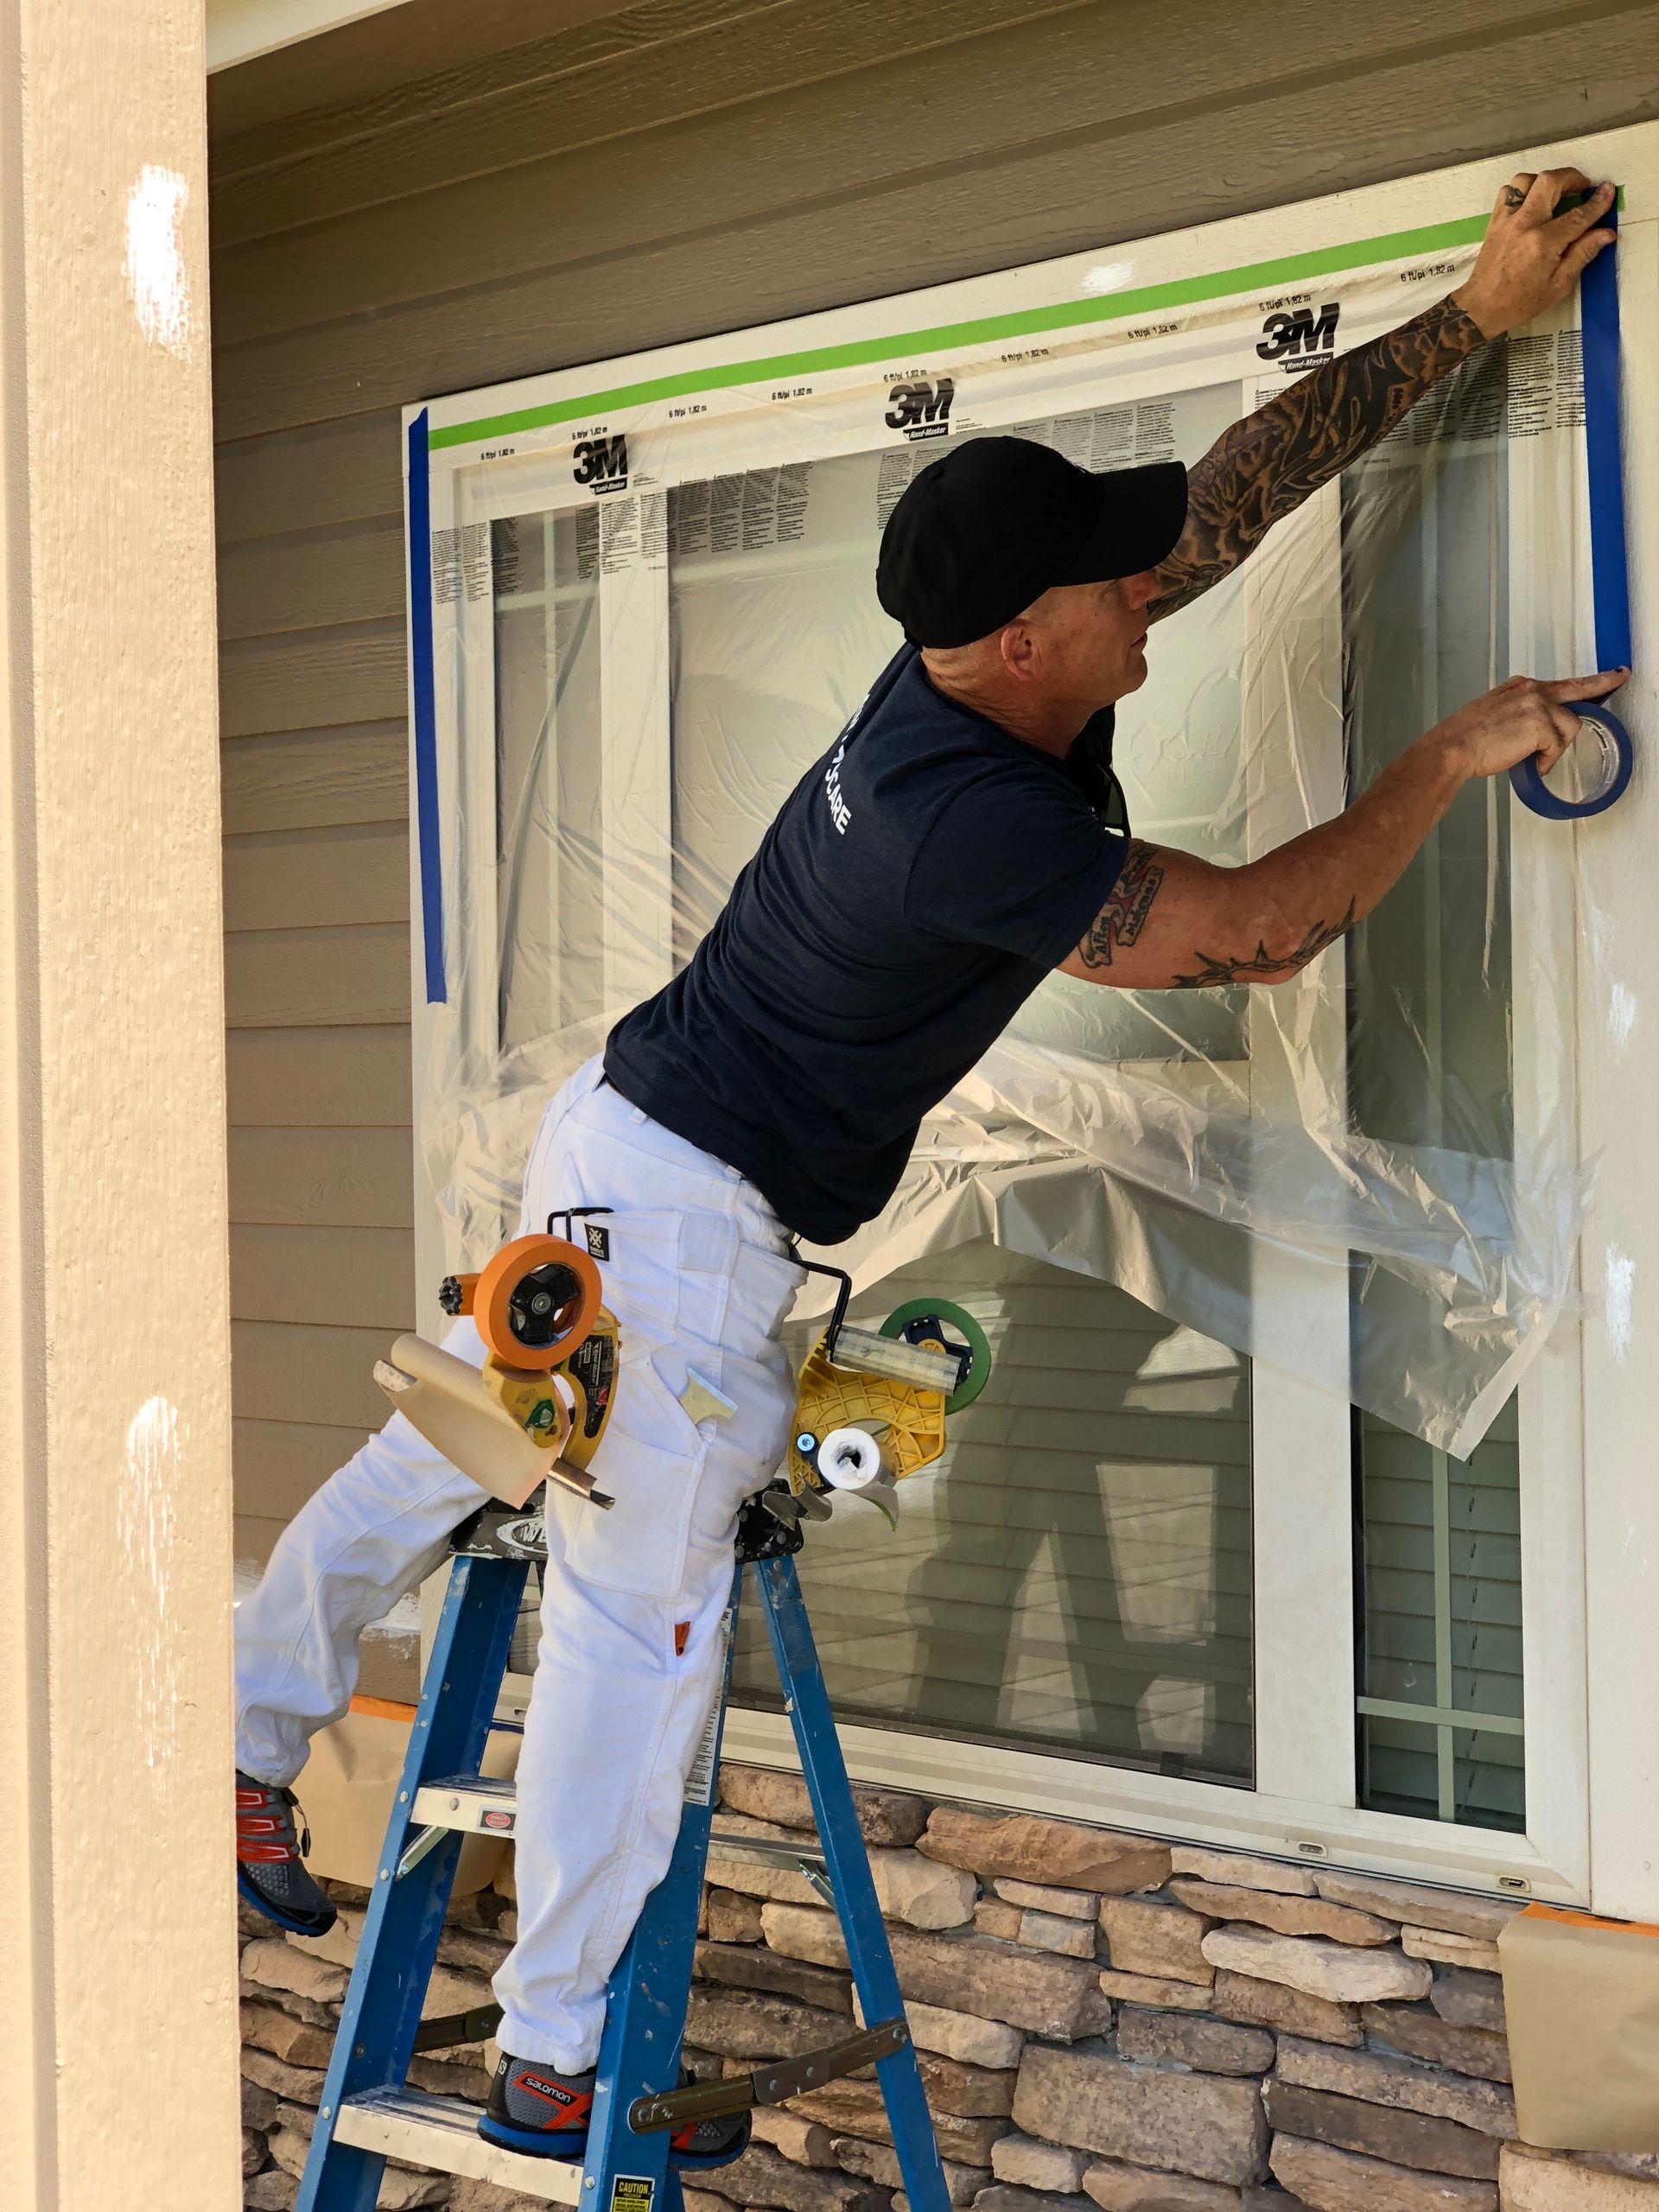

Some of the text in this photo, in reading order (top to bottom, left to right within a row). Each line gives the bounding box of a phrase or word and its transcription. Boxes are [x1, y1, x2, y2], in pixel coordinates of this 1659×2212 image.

[1400, 264, 1455, 283] 6 ft/pi 1,82 m
[1258, 302, 1265, 311] 6
[1266, 298, 1284, 310] ft/pi
[1285, 295, 1302, 307] 1,82
[1134, 327, 1151, 339] ft/pi
[1153, 324, 1168, 335] 1,82
[1169, 323, 1178, 332] m
[1255, 302, 1339, 360] 3M
[1007, 351, 1024, 362] ft/pi
[1026, 348, 1040, 359] 1,82
[1285, 355, 1332, 371] Hand-Masker
[920, 368, 927, 377] m
[792, 387, 805, 398] 1,82
[688, 404, 700, 415] 1,82
[885, 378, 955, 429] 3M
[909, 426, 946, 438] Hand-Masker
[573, 434, 628, 485] 3M
[525, 2077, 571, 2103] salomon
[618, 2181, 649, 2195] CAUTION
